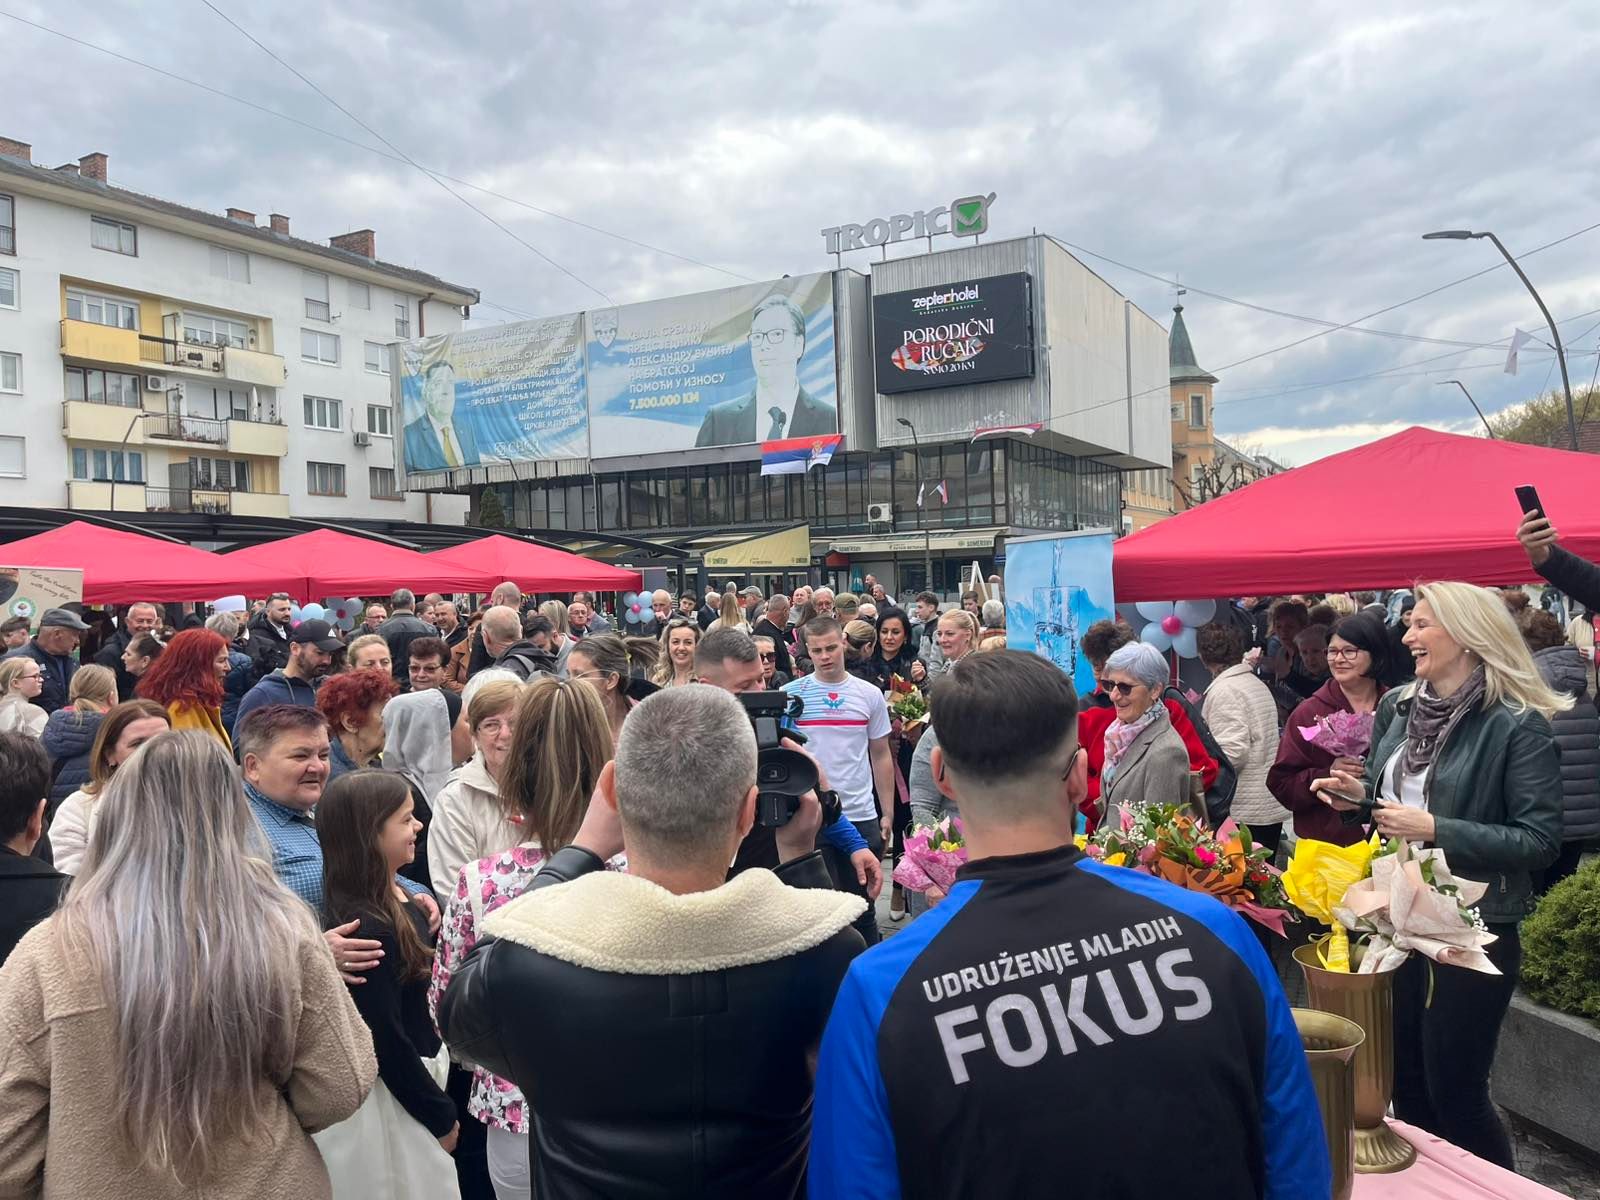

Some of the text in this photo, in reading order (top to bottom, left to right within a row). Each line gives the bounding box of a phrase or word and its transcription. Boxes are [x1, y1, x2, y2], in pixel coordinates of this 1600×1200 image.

[821, 206, 947, 254] TROPIC
[903, 317, 995, 346] PORODIČNI
[627, 349, 693, 368] АЛЕКСАНДРУ
[921, 339, 978, 361] RUČAK
[629, 372, 725, 394] ПОМОЋИ У ИЗНОСУ
[644, 362, 696, 379] БРАТСКОЈ
[922, 915, 1184, 1003] UDRUŽENJE MLADIH
[934, 948, 1213, 1085] FOKUS
